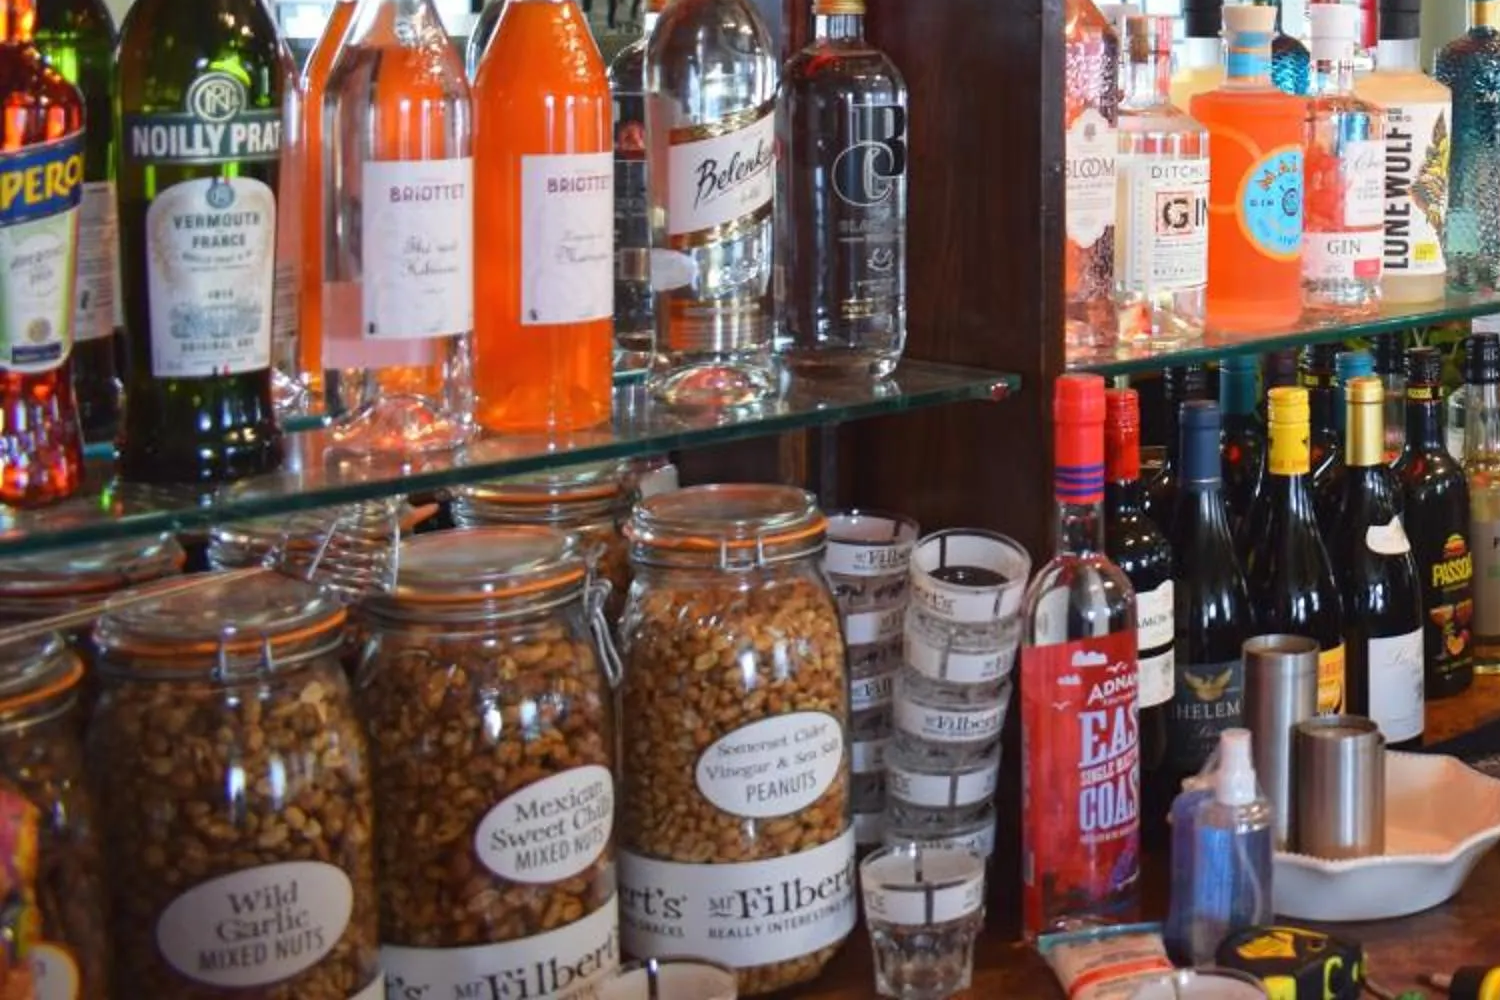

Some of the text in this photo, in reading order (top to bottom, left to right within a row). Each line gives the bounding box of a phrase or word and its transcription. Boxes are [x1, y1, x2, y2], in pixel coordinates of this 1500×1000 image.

[132, 119, 281, 158] NOILLY PRAT
[0, 152, 84, 211] PERO
[172, 211, 261, 230] VERMOUTH
[191, 233, 246, 249] FRANCE
[717, 722, 829, 756] Somerset Cider
[705, 761, 770, 782] Vinegar
[776, 756, 789, 770] &
[795, 750, 818, 764] Sea
[513, 780, 603, 823] Mexican
[745, 769, 818, 804] PEANUTS
[490, 817, 565, 851] Sweet
[514, 839, 570, 873] MIXED
[227, 879, 298, 915] Wild
[216, 908, 310, 943] Garlic
[708, 923, 762, 939] REALLY
[198, 926, 325, 972] MIXED NUTS
